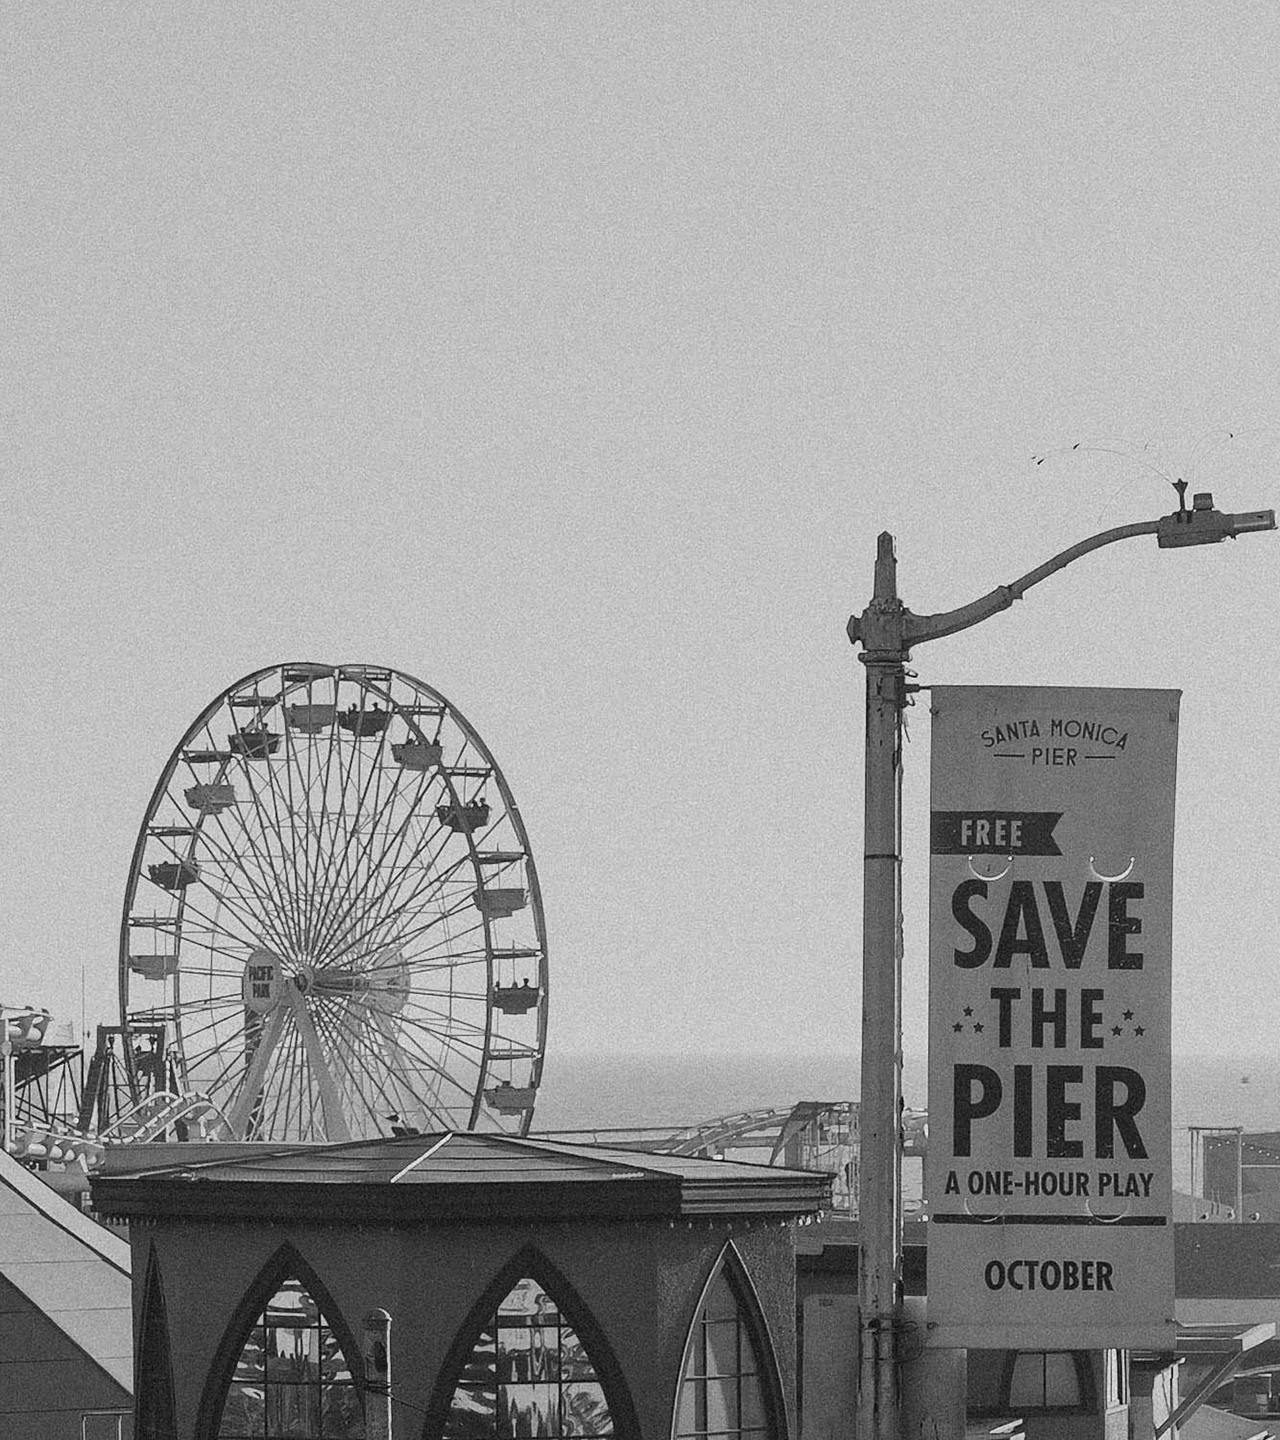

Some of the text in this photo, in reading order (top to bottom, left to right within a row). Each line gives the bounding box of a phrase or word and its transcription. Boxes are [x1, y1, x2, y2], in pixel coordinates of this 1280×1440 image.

[981, 719, 1129, 750] SANTA MONICA
[1032, 748, 1077, 766] PIER
[961, 819, 1023, 847] FREE
[952, 879, 1144, 970] SAVE
[990, 988, 1105, 1049] THE
[953, 1064, 1149, 1159] PIER
[945, 1171, 1154, 1197] A ONE-HOUR PLAY
[985, 1260, 1114, 1291] OCTOBER
